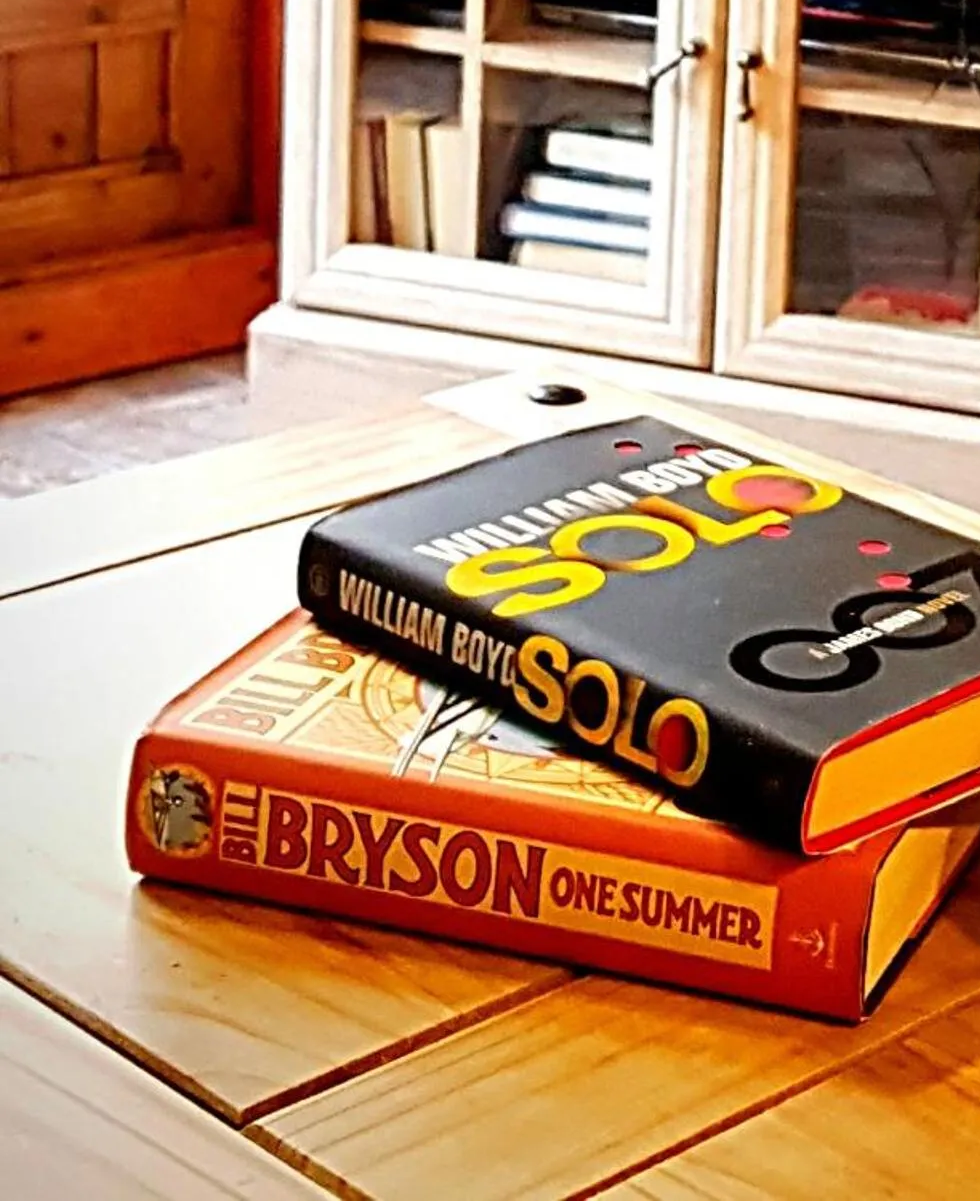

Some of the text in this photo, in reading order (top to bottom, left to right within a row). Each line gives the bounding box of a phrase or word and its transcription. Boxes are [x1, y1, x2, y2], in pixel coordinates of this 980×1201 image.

[413, 448, 754, 564] WILLIAM BOYD
[445, 465, 843, 617] SOLO
[339, 569, 447, 655] WILLIAM
[451, 621, 517, 687] BOYD
[191, 674, 334, 736] BILL
[513, 634, 710, 787] SOLO
[220, 792, 257, 865] BILL
[263, 794, 547, 919] BRYSON
[550, 866, 618, 917] ONE
[619, 881, 763, 949] SUMMER
